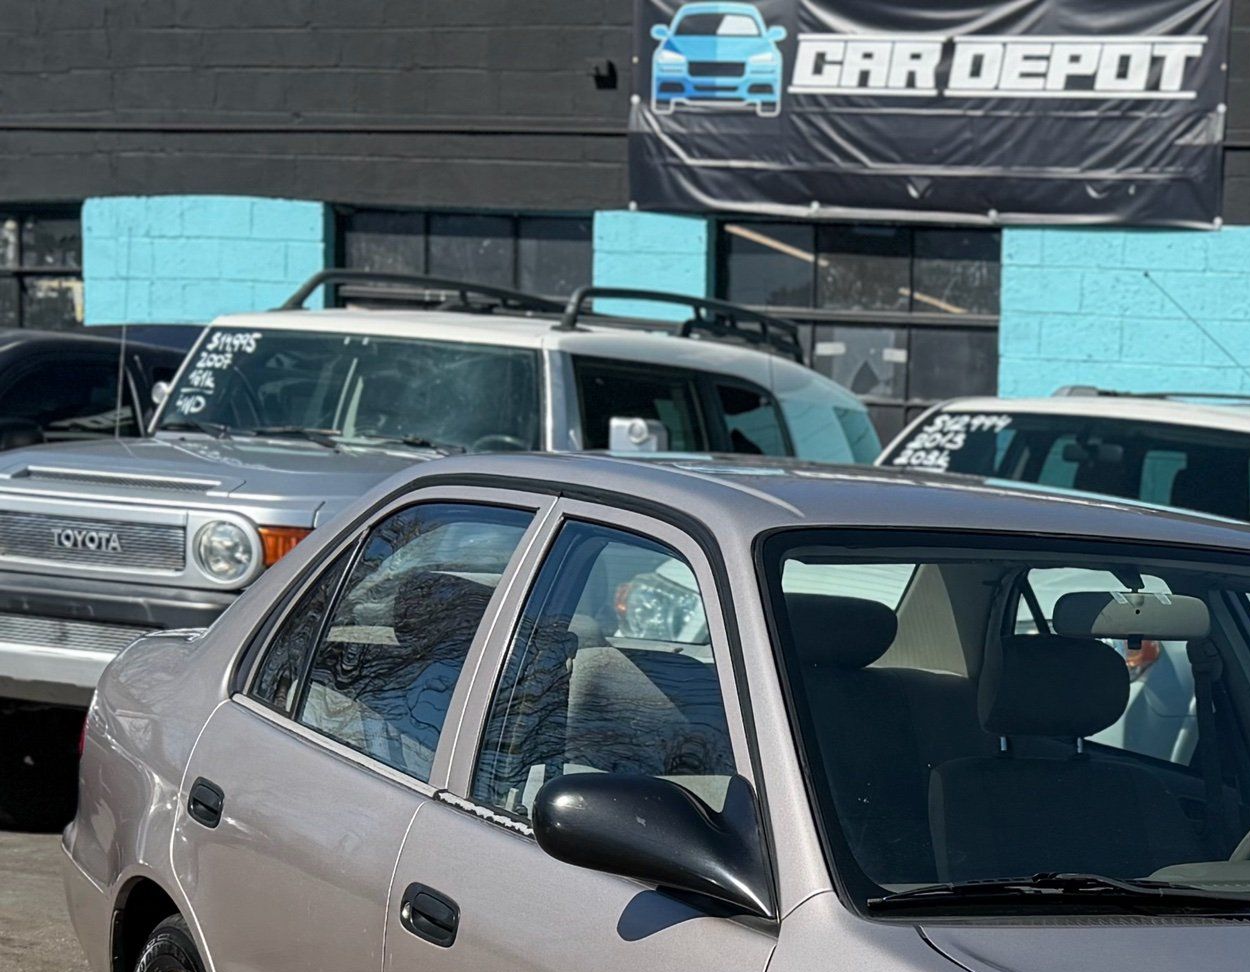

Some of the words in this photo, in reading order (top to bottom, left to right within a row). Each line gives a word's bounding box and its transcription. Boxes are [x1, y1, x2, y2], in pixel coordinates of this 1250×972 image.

[791, 38, 943, 90] CAR
[948, 40, 1204, 94] DEPOT
[195, 351, 233, 369] 2007
[50, 528, 124, 553] TOYOTA
